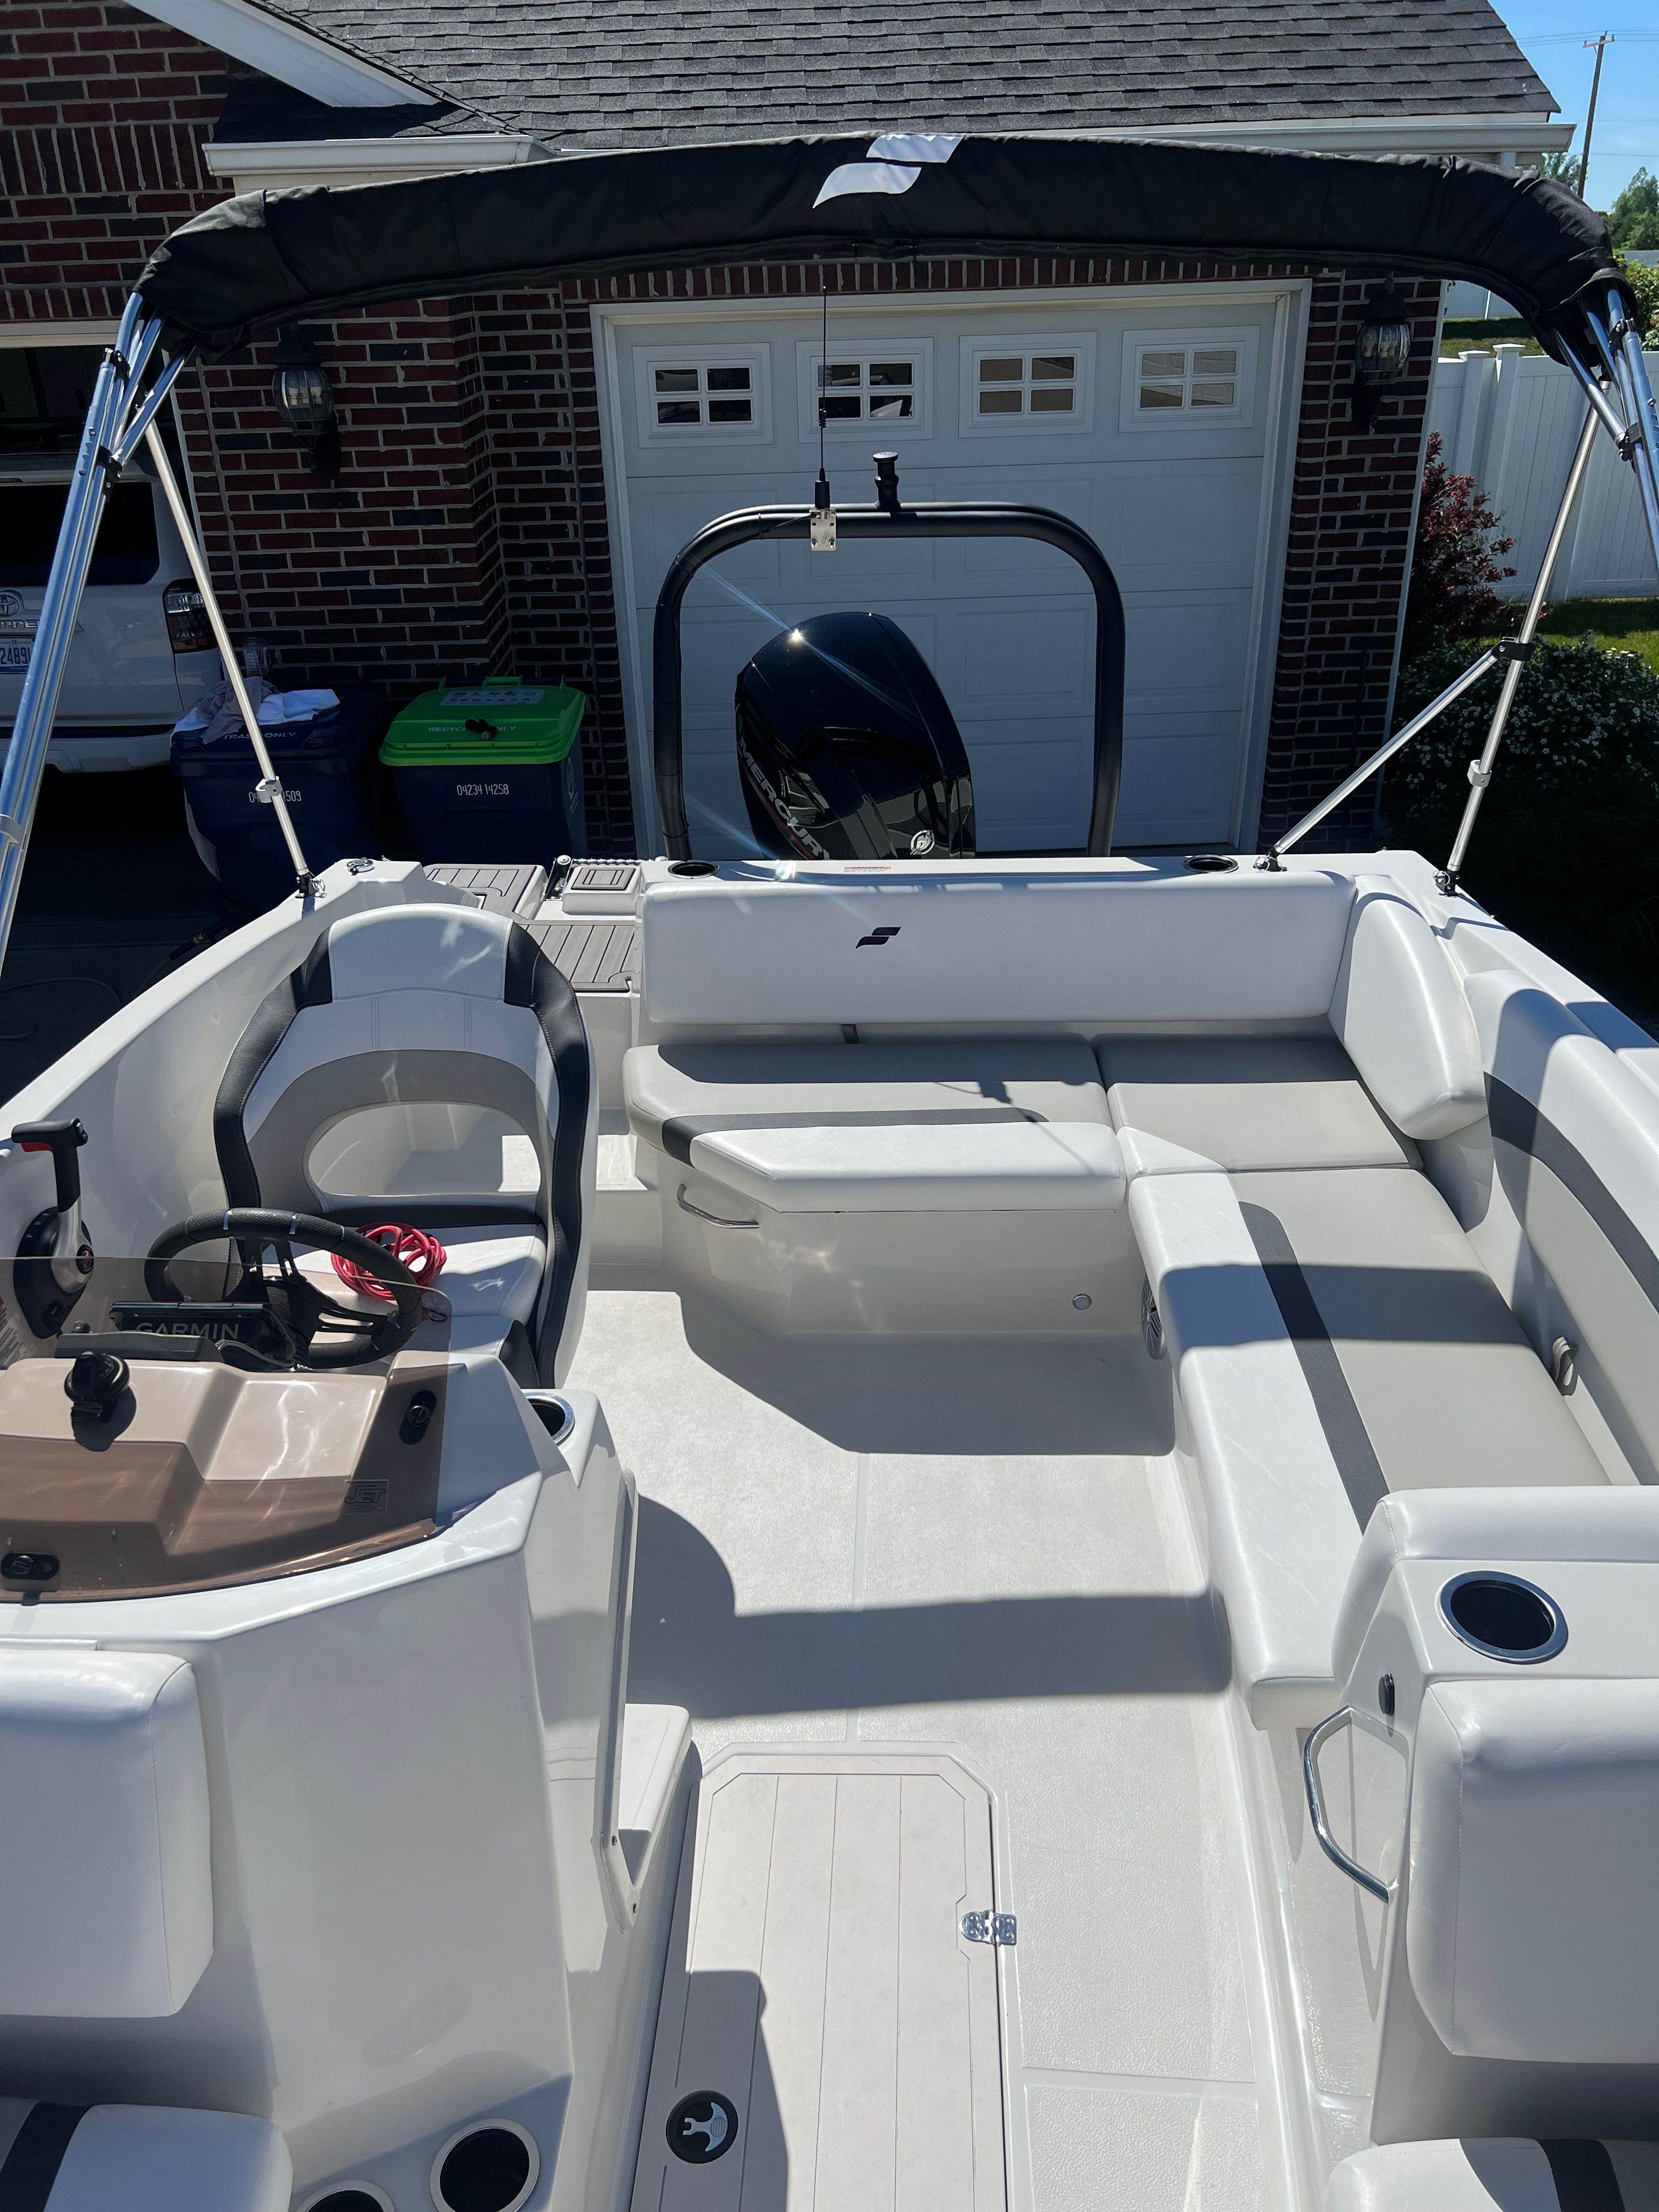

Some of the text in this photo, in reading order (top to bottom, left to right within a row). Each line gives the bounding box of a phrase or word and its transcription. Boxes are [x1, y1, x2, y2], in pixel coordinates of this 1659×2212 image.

[456, 783, 509, 796] 04234 14258
[136, 1322, 239, 1339] GARMIN
[344, 1485, 387, 1504] JET
